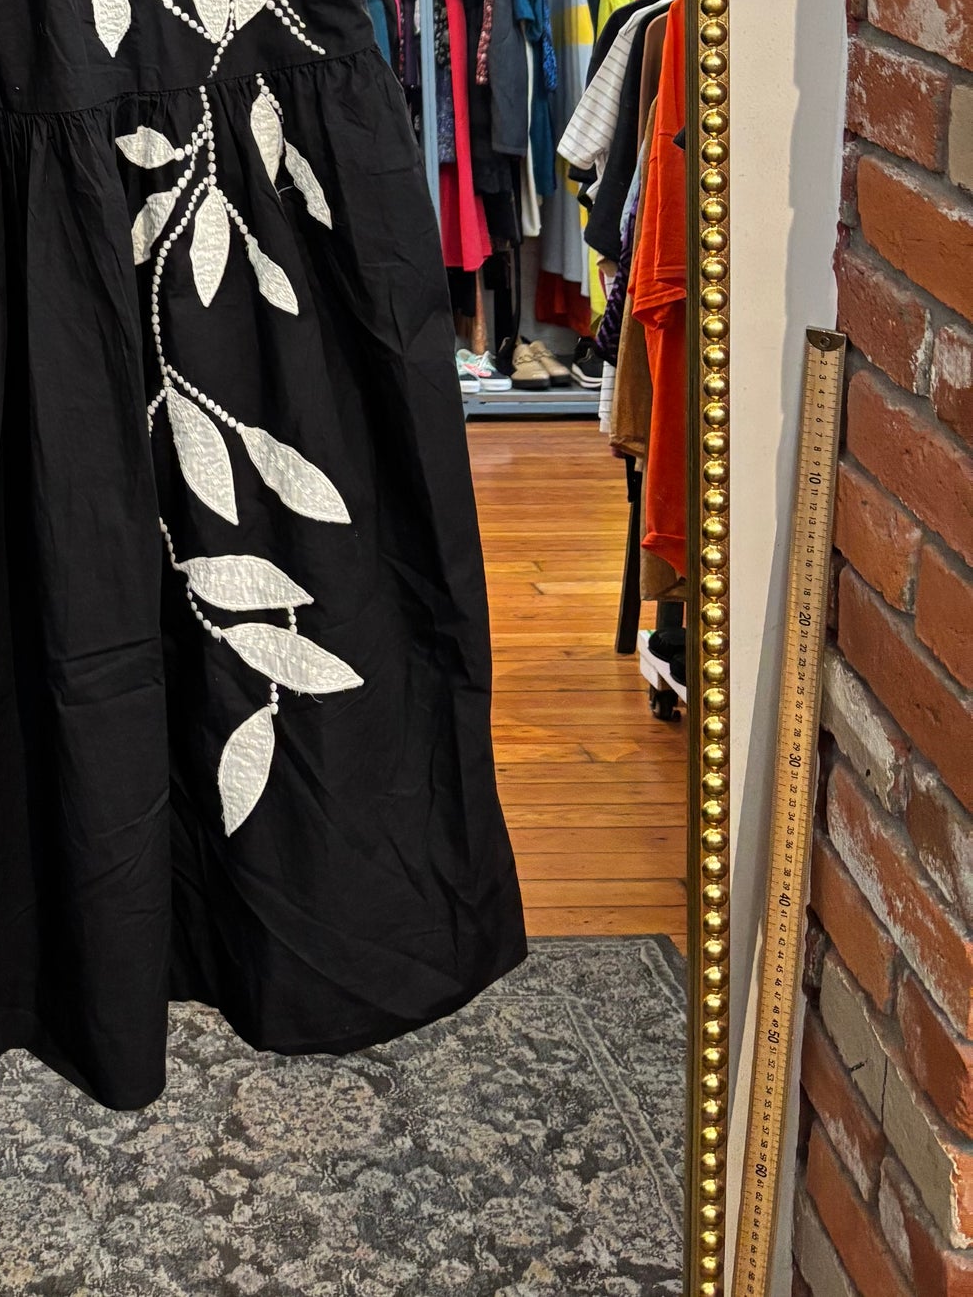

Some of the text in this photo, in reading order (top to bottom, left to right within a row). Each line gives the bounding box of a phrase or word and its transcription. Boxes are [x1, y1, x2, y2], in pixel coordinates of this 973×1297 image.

[808, 472, 822, 485] 10
[810, 488, 819, 496] 11
[809, 502, 818, 511] 12
[808, 516, 817, 525] 13
[808, 531, 816, 540] 14
[806, 545, 815, 554] 15
[805, 559, 814, 568] 16
[805, 573, 813, 582] 17
[803, 587, 812, 597] 18
[802, 602, 811, 611] 19
[798, 611, 812, 627] 20
[800, 629, 809, 639] 21
[799, 643, 808, 653] 22
[798, 657, 807, 667] 23
[797, 671, 806, 681] 24
[796, 686, 805, 696] 25
[795, 700, 804, 710] 26
[794, 713, 803, 724] 27
[793, 727, 802, 738] 28
[792, 741, 801, 752] 29
[788, 753, 802, 768] 30
[790, 770, 799, 780] 31
[789, 783, 798, 794] 32
[788, 797, 797, 808] 33
[788, 811, 796, 822] 34
[786, 825, 795, 836] 35
[785, 839, 794, 849] 36
[784, 853, 793, 864] 37
[783, 867, 792, 877] 38
[782, 880, 791, 891] 39
[778, 892, 791, 907] 40
[780, 909, 788, 918] 41
[779, 923, 787, 933] 42
[778, 937, 786, 947] 43
[777, 950, 784, 960] 44
[775, 964, 784, 974] 45
[774, 977, 782, 987] 46
[774, 991, 782, 1001] 47
[772, 1005, 780, 1015] 48
[771, 1018, 779, 1028] 49
[767, 1029, 780, 1044] 50
[769, 1045, 777, 1055] 51
[767, 1058, 776, 1069] 52
[766, 1071, 775, 1082] 53
[765, 1085, 774, 1095] 54
[764, 1098, 772, 1109] 55
[762, 1111, 771, 1121] 56
[762, 1125, 770, 1136] 57
[755, 1163, 768, 1178] 60
